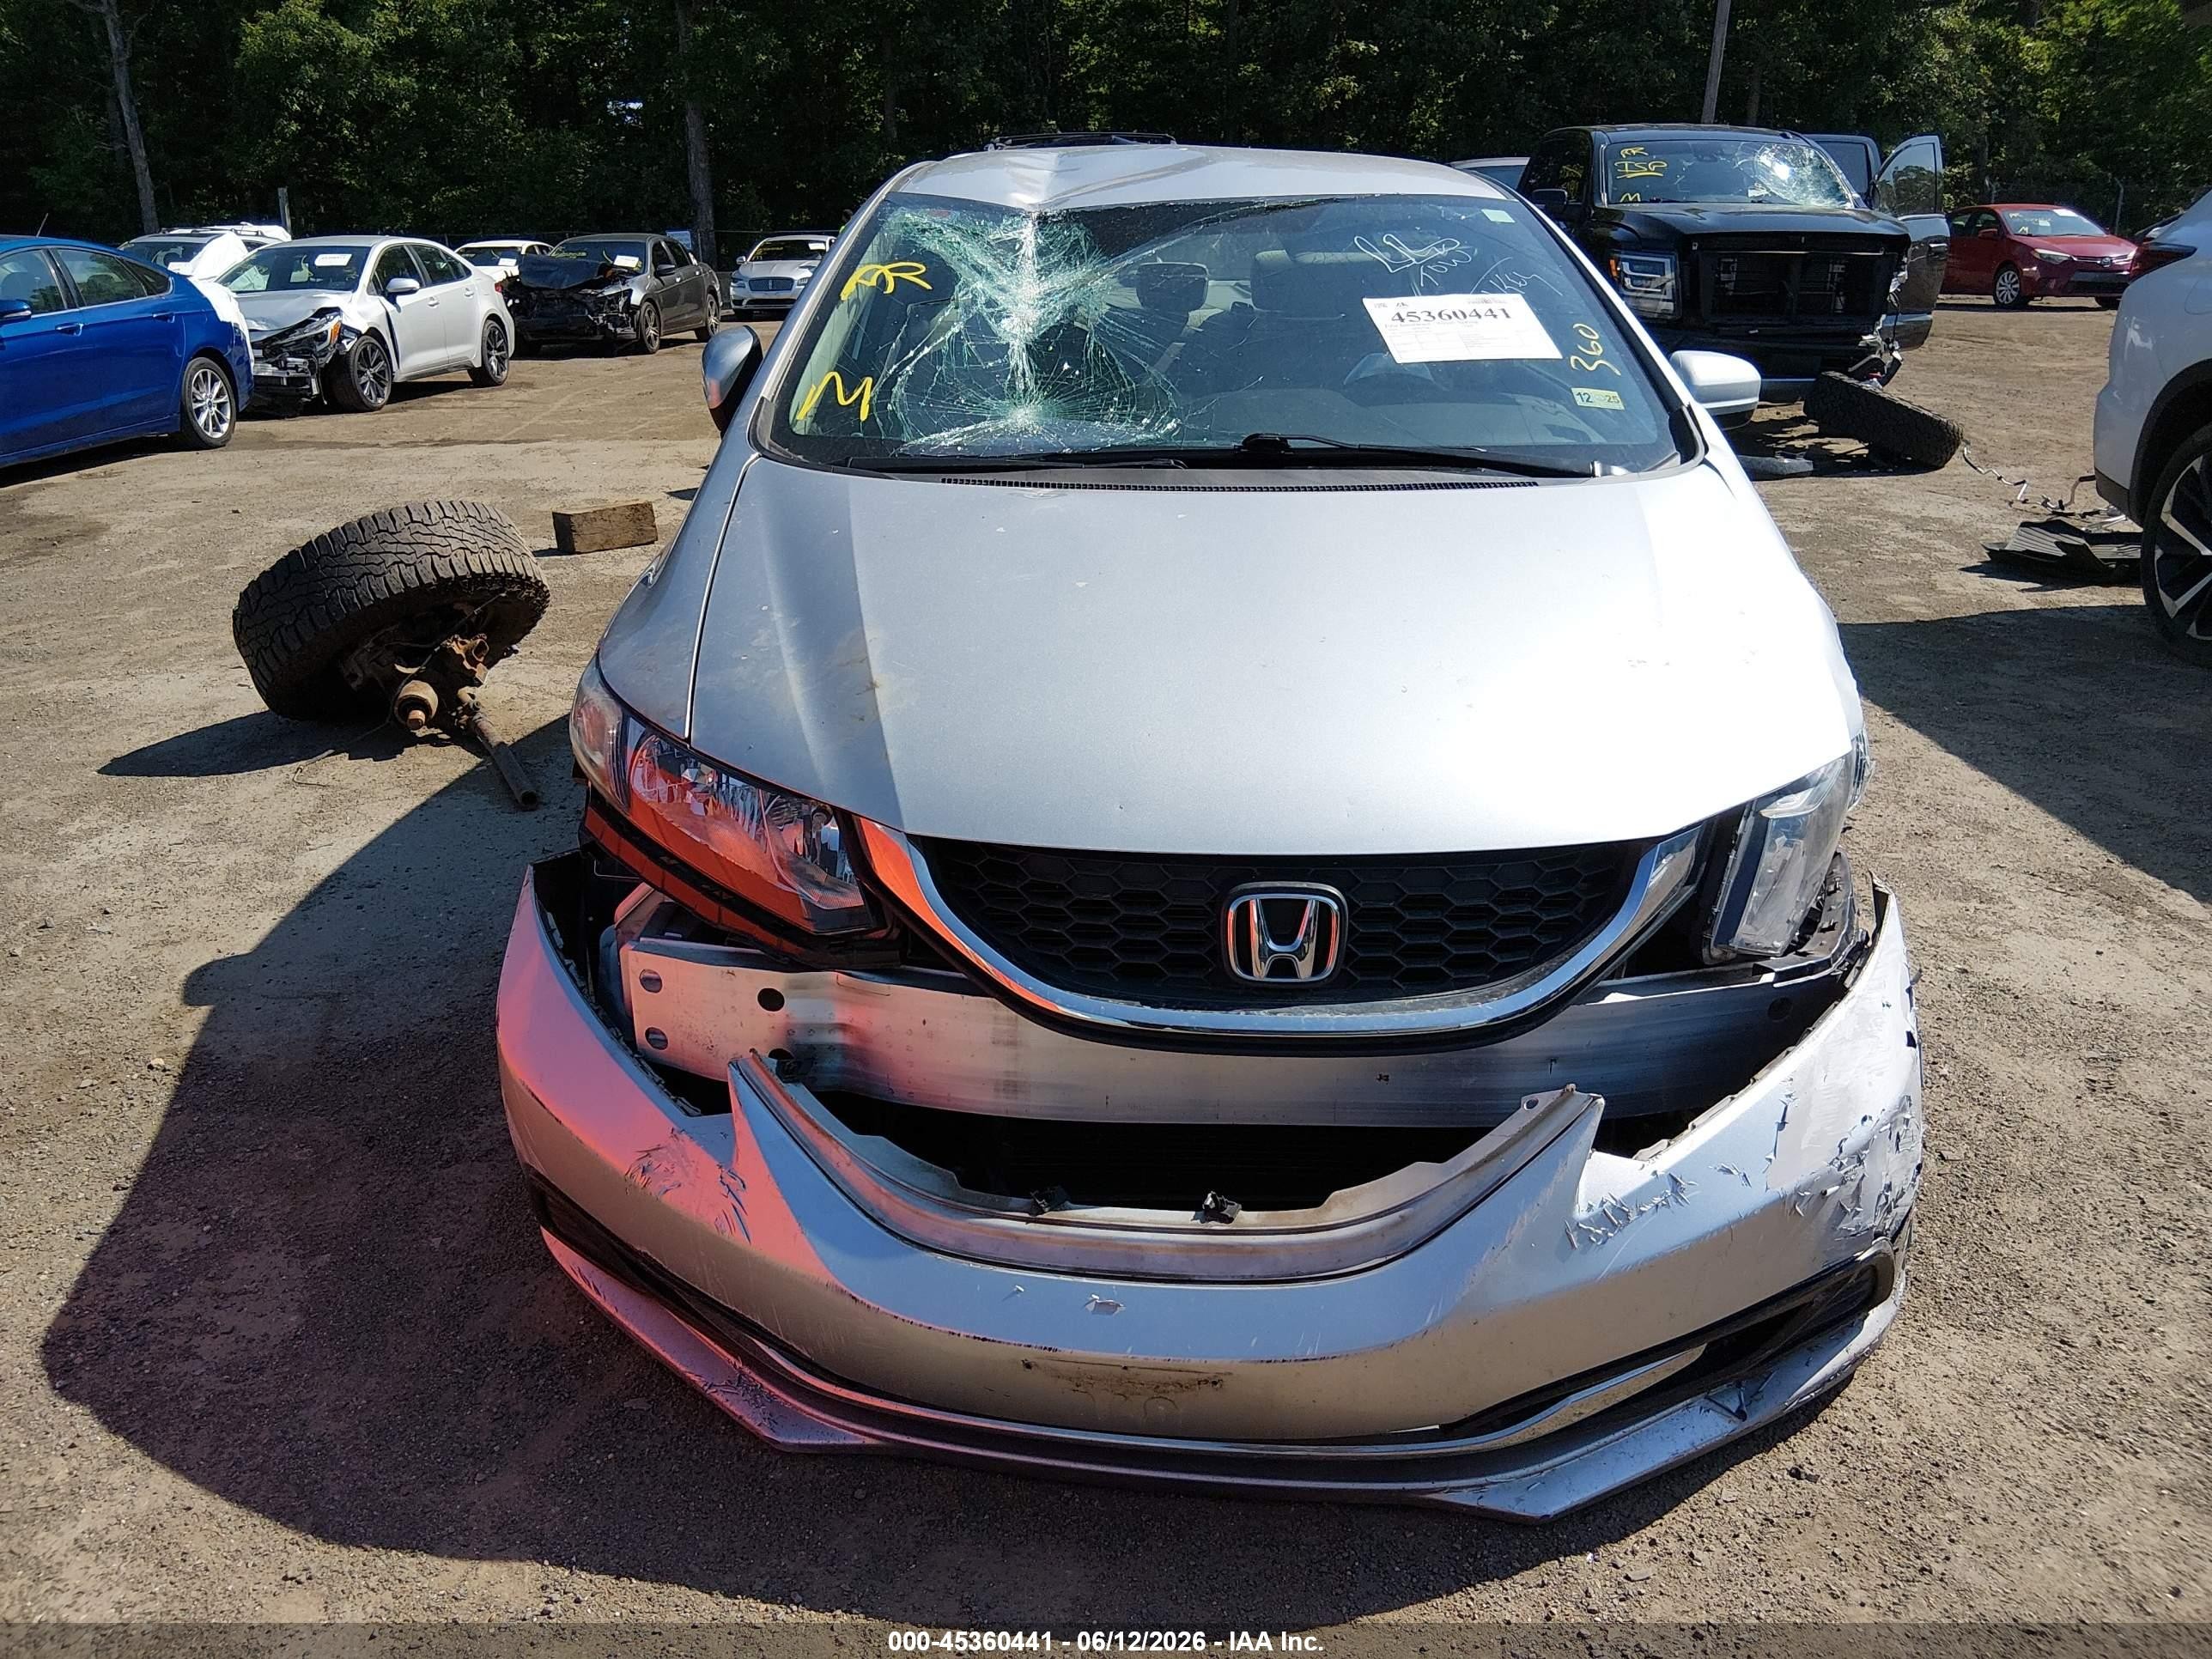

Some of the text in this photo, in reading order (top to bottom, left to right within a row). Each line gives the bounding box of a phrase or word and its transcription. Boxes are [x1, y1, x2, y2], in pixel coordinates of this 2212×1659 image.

[1391, 307, 1512, 324] 45360441
[1570, 323, 1621, 376] 360
[1577, 392, 1620, 404] 12 25
